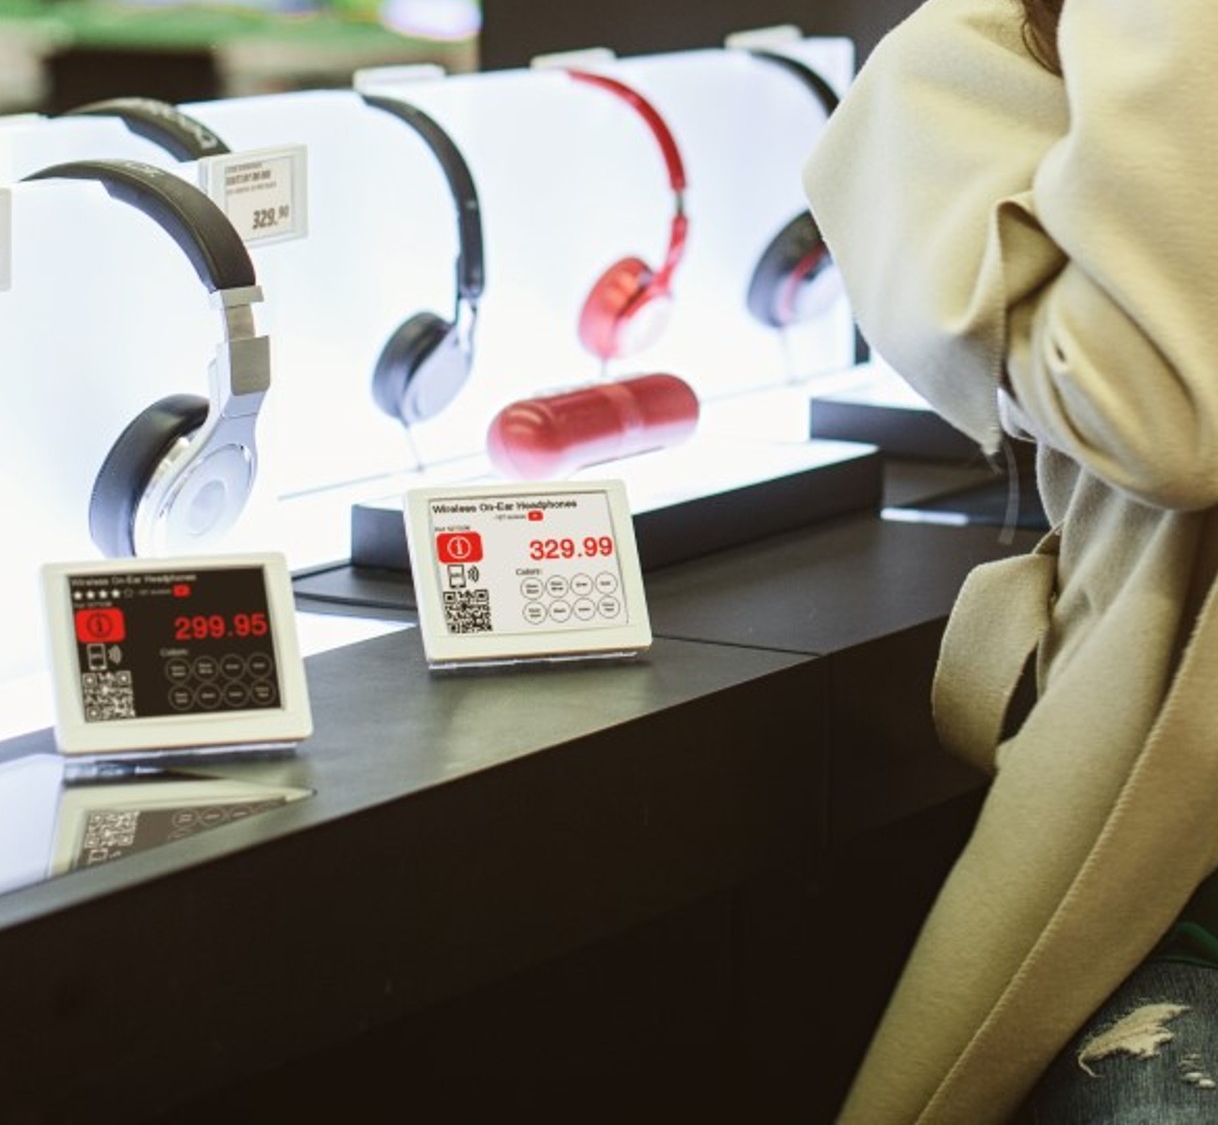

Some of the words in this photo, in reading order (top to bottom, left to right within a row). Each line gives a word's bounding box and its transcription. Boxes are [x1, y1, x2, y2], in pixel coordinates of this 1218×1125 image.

[432, 503, 477, 514] Wireless
[479, 501, 514, 512] On-Ear
[516, 498, 578, 511] Headphones
[529, 536, 613, 561] 329.99
[174, 612, 268, 641] 299.95
